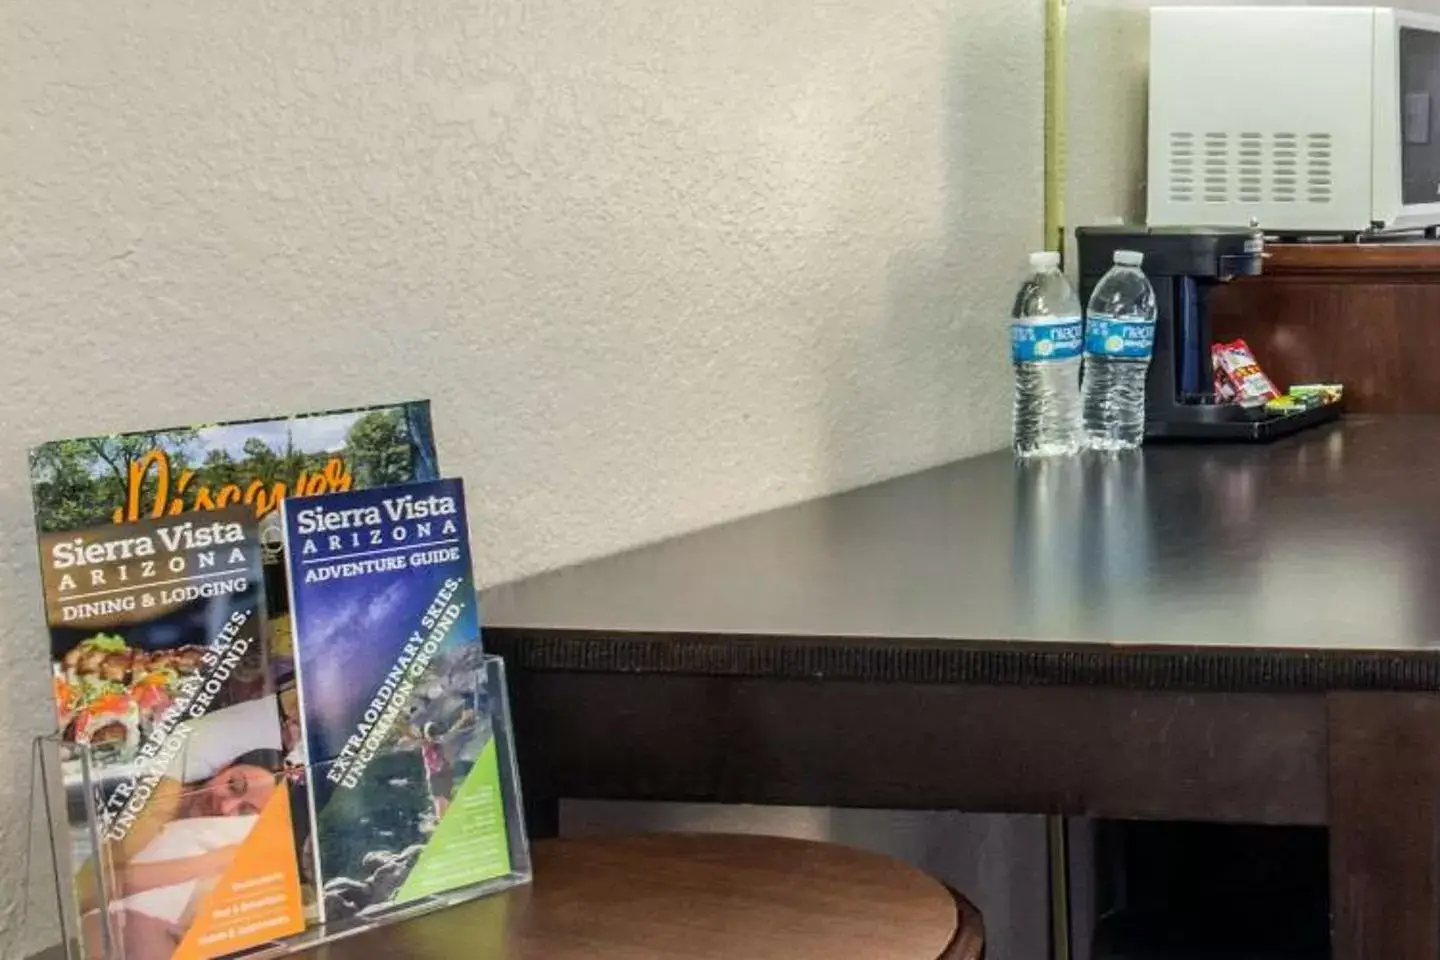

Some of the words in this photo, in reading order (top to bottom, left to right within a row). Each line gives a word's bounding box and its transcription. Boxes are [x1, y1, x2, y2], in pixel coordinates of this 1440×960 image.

[297, 507, 379, 534] Sierra
[382, 495, 457, 521] Vista
[303, 519, 457, 554] ARIZONA
[53, 534, 155, 569] Sierra
[157, 520, 245, 552] Vista
[305, 557, 406, 583] ADVENTURE
[411, 548, 460, 565] GUIDE
[58, 549, 246, 592] ARIZONA
[63, 593, 135, 622] DINING
[142, 591, 155, 607] &
[161, 576, 248, 603] LODGING
[202, 607, 252, 667] SKIES.
[326, 630, 424, 783] EXTRAORDINARY
[421, 576, 463, 630] SKIES.
[341, 679, 414, 789] UNCOMMON
[411, 601, 466, 678] GROUND.
[106, 721, 193, 842] UNCOMMON
[189, 636, 254, 719] GROUND.
